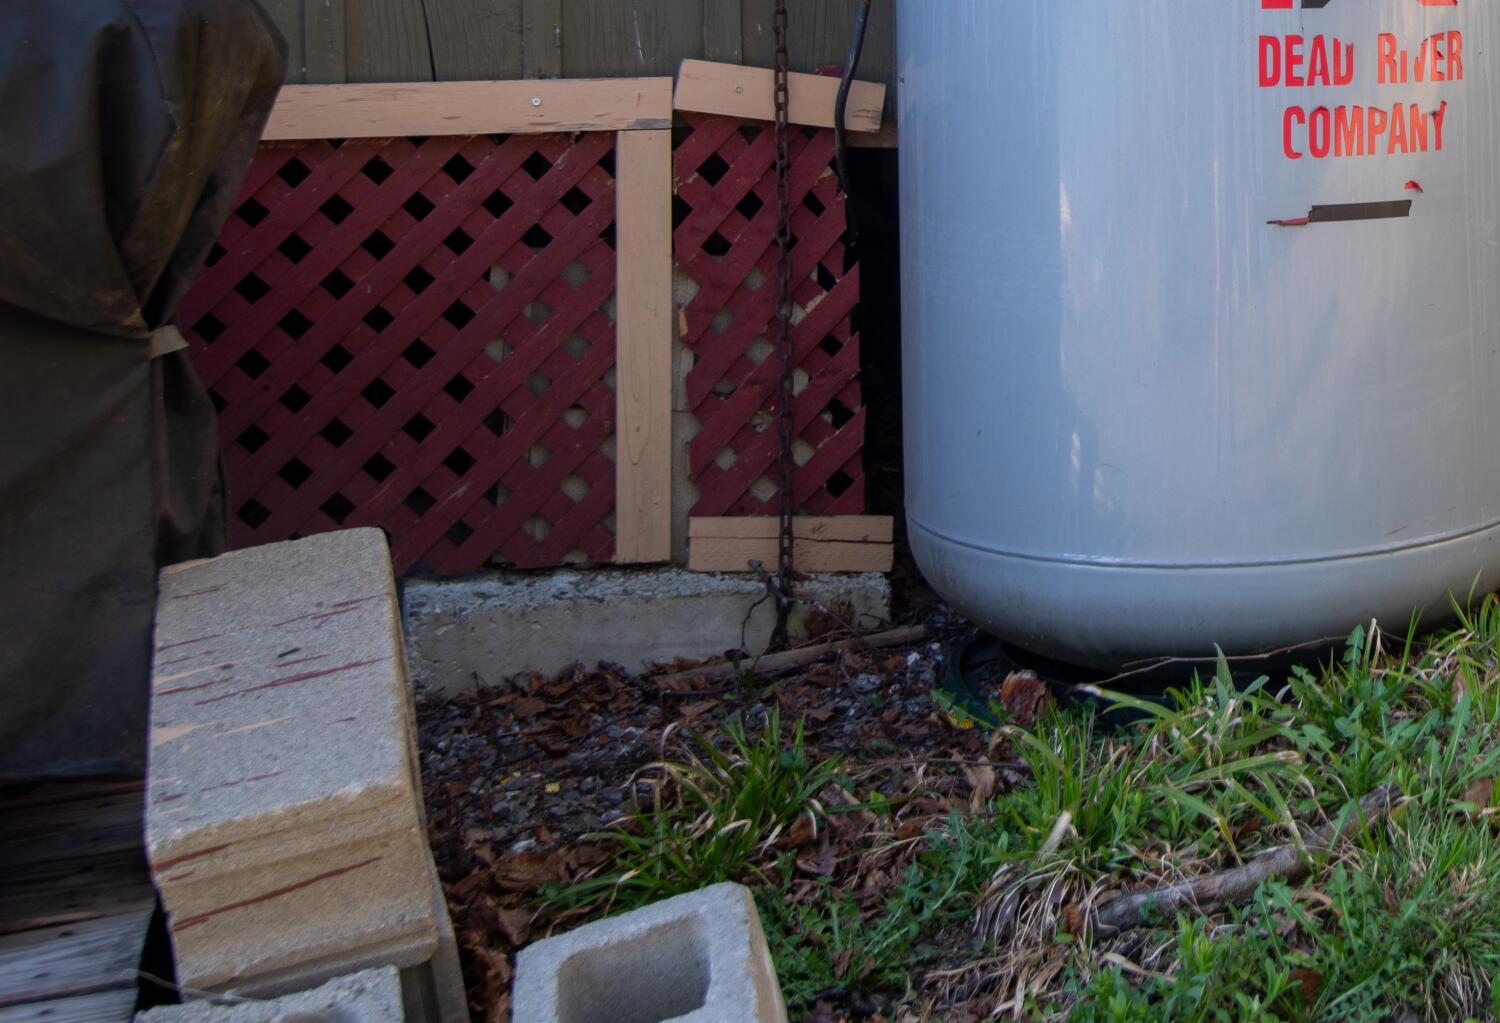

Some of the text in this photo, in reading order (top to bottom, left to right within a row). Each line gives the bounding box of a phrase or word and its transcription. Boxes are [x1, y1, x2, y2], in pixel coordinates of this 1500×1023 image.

[1258, 30, 1464, 88] DEAD RIVER
[1282, 100, 1448, 160] COMPANY
